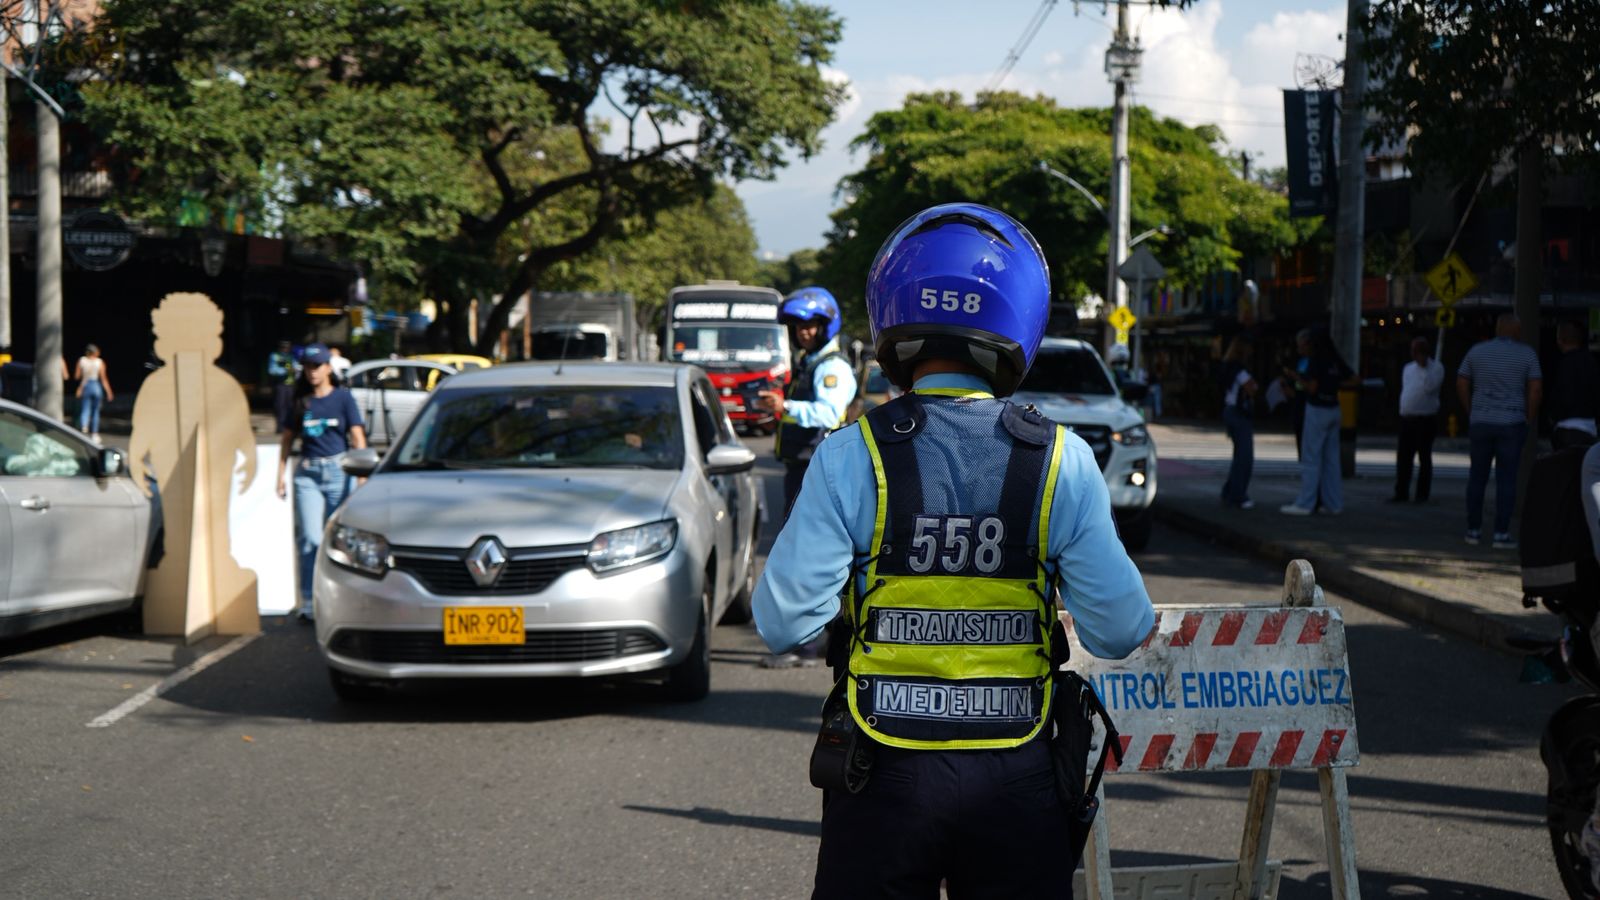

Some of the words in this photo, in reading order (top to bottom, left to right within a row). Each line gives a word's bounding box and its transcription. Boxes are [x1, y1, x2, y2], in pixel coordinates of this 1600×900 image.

[1305, 90, 1322, 186] DEPORTE
[920, 287, 982, 314] 558
[908, 517, 1004, 573] 558
[447, 613, 481, 635] INR
[486, 613, 520, 635] 902
[888, 611, 1028, 642] TRANSITO
[880, 683, 1029, 717] MEDELLIN
[1088, 671, 1177, 710] NTROL
[1180, 669, 1350, 709] EMBRIAGUEZ
